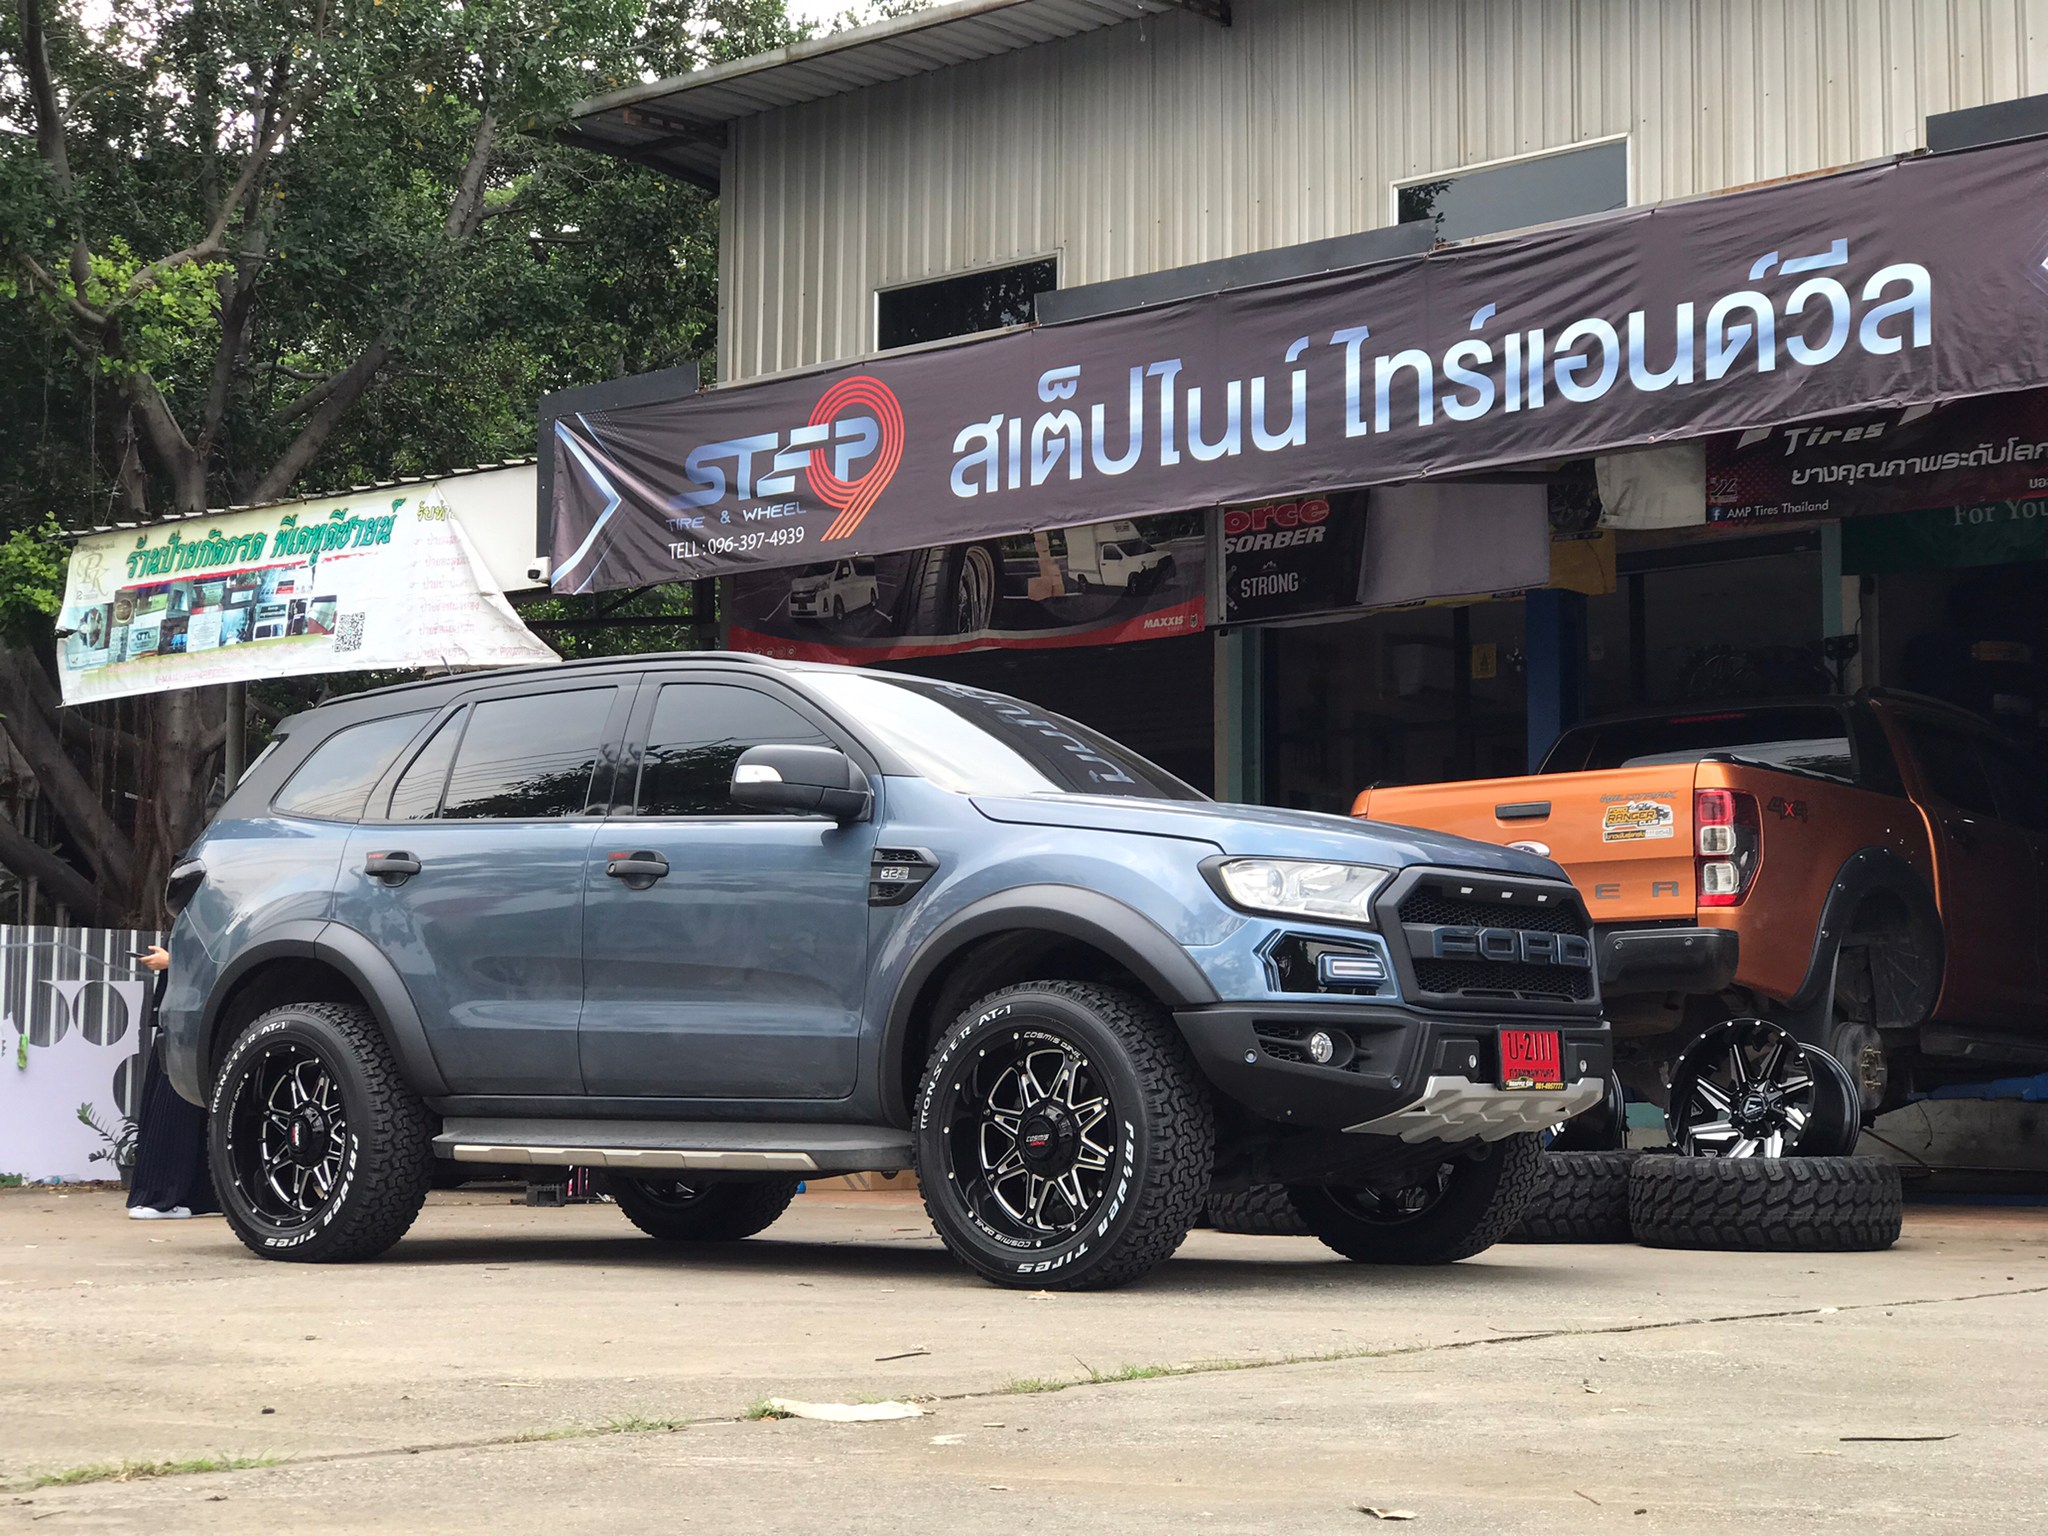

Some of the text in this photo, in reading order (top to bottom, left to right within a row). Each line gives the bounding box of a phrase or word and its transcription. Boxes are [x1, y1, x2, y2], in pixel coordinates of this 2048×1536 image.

[950, 238, 1932, 498] สเต็ปไนน์ ไทร์แอนด์วีล
[1784, 422, 1886, 456] Tires
[667, 375, 905, 542] STEP 9
[666, 501, 807, 532] TIRE & WHEEL
[1727, 500, 1829, 518] AMP Tires Thailand
[708, 526, 805, 555] 096-397-4939
[1241, 572, 1299, 598] STRONG
[1144, 616, 1184, 629] MAXXIS
[1608, 811, 1655, 822] RANGER
[1431, 927, 1591, 968] FORD
[1024, 1031, 1060, 1044] COSMIS
[212, 1021, 286, 1113] MONSTER AT-1
[921, 1004, 1011, 1129] MONSTER AT-1
